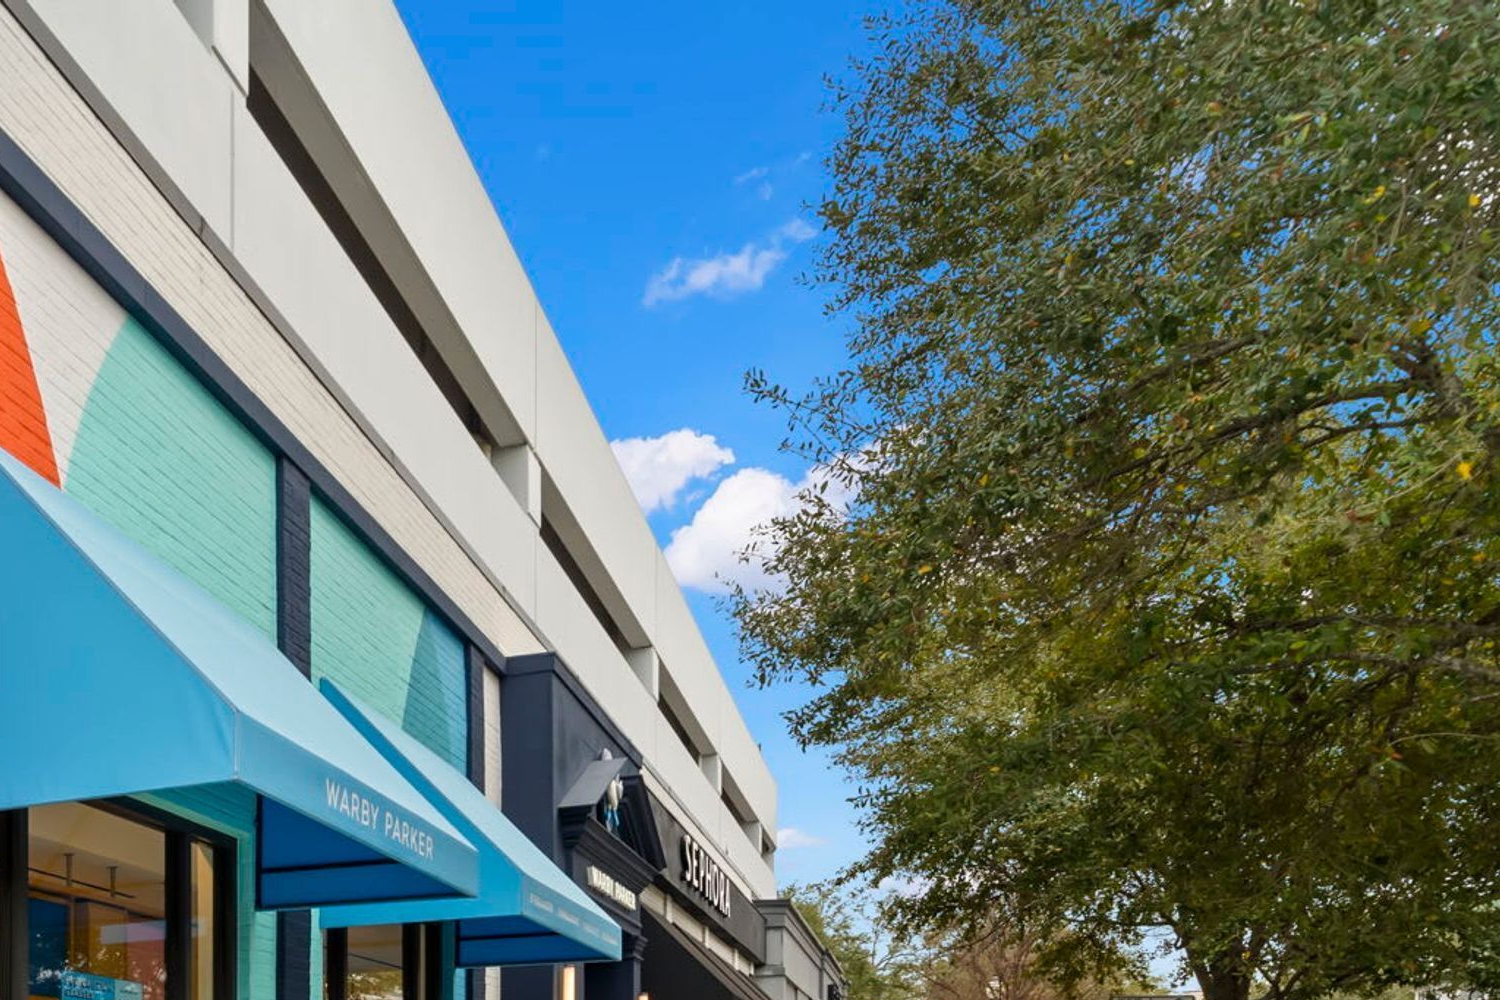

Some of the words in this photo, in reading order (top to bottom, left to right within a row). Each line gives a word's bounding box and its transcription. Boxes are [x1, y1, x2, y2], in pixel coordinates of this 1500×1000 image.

[325, 776, 380, 830] WARBY
[384, 811, 435, 861] PARKER
[683, 834, 731, 918] SEPHORA
